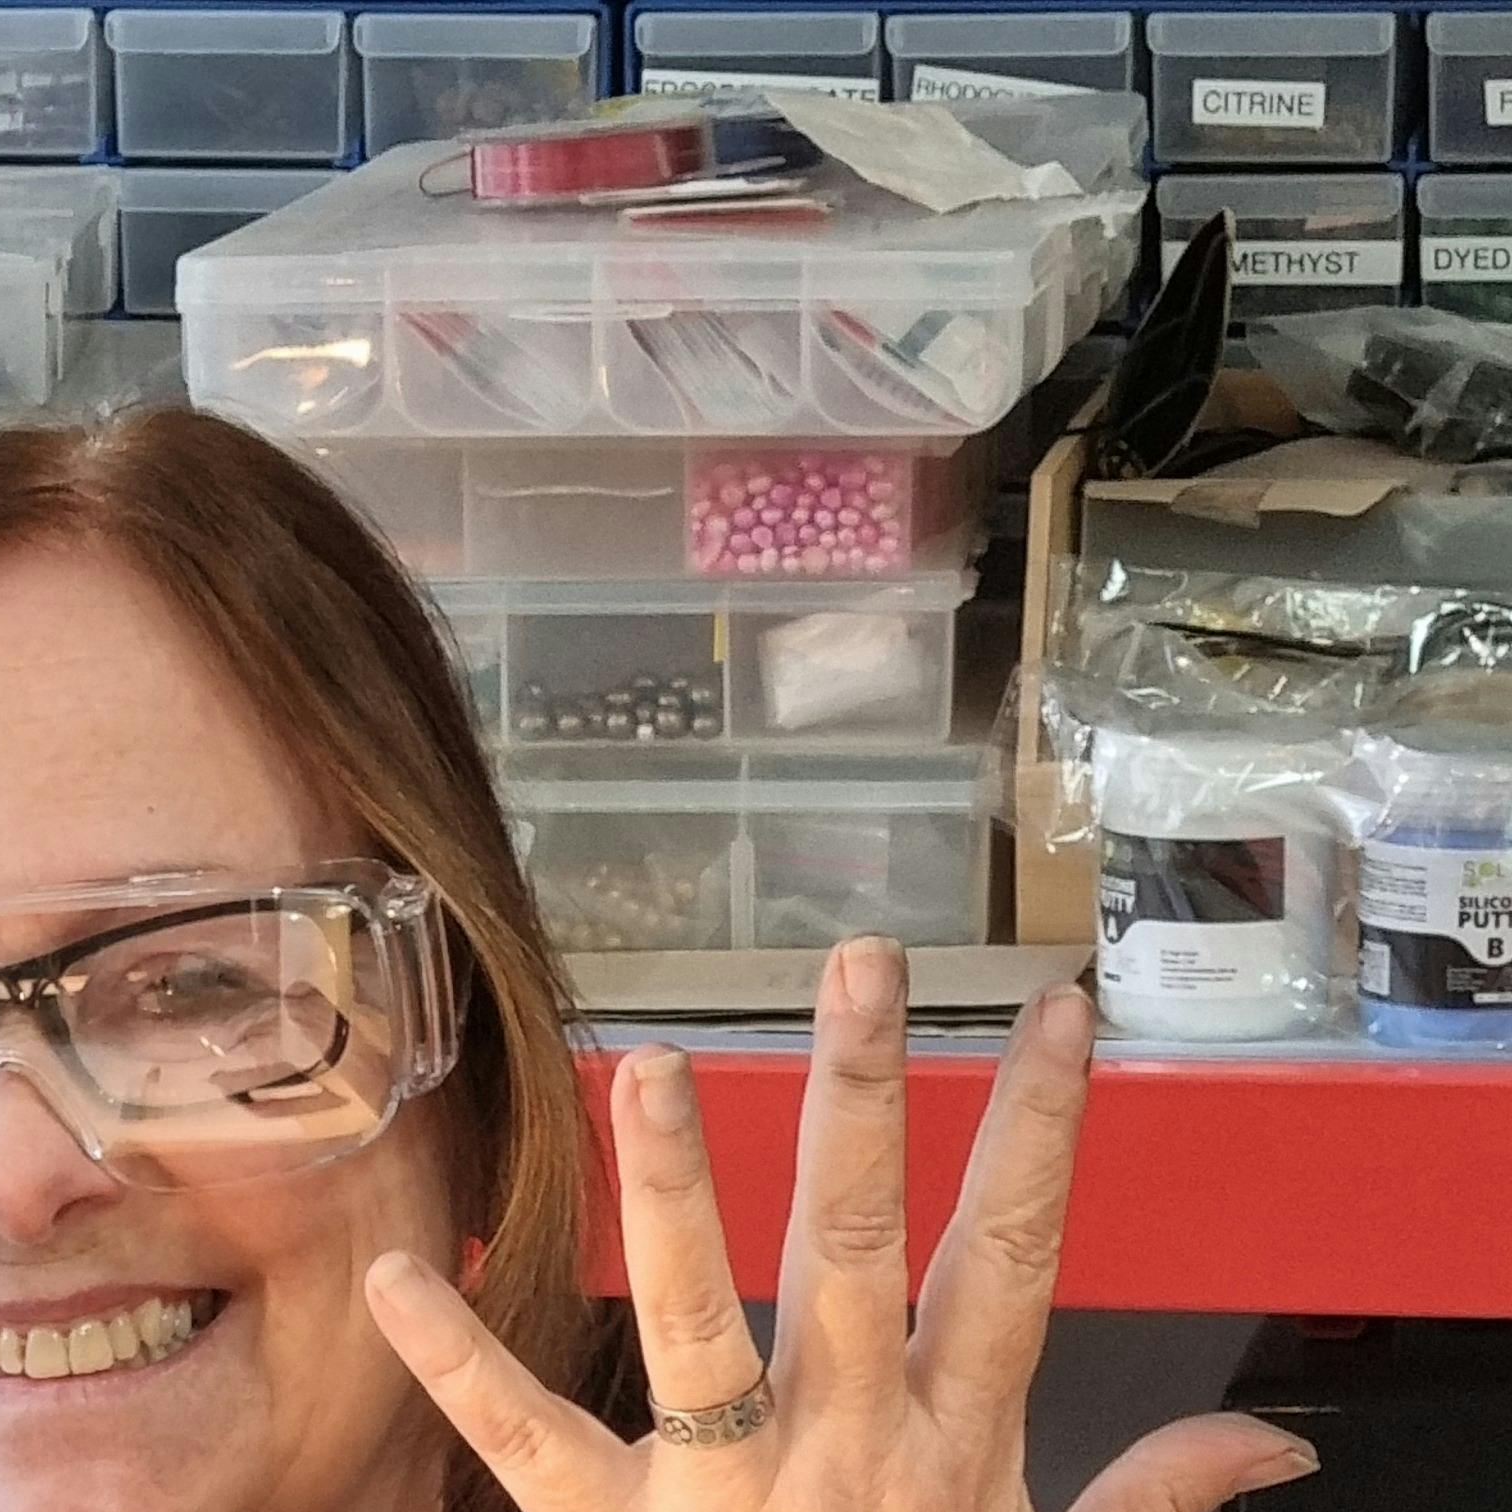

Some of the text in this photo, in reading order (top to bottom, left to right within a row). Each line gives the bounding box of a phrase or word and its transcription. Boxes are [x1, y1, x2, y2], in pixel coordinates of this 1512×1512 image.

[1202, 89, 1315, 116] CITRINE
[1231, 250, 1361, 276] METHYST
[1433, 247, 1511, 271] DYED
[1487, 937, 1505, 959] B
